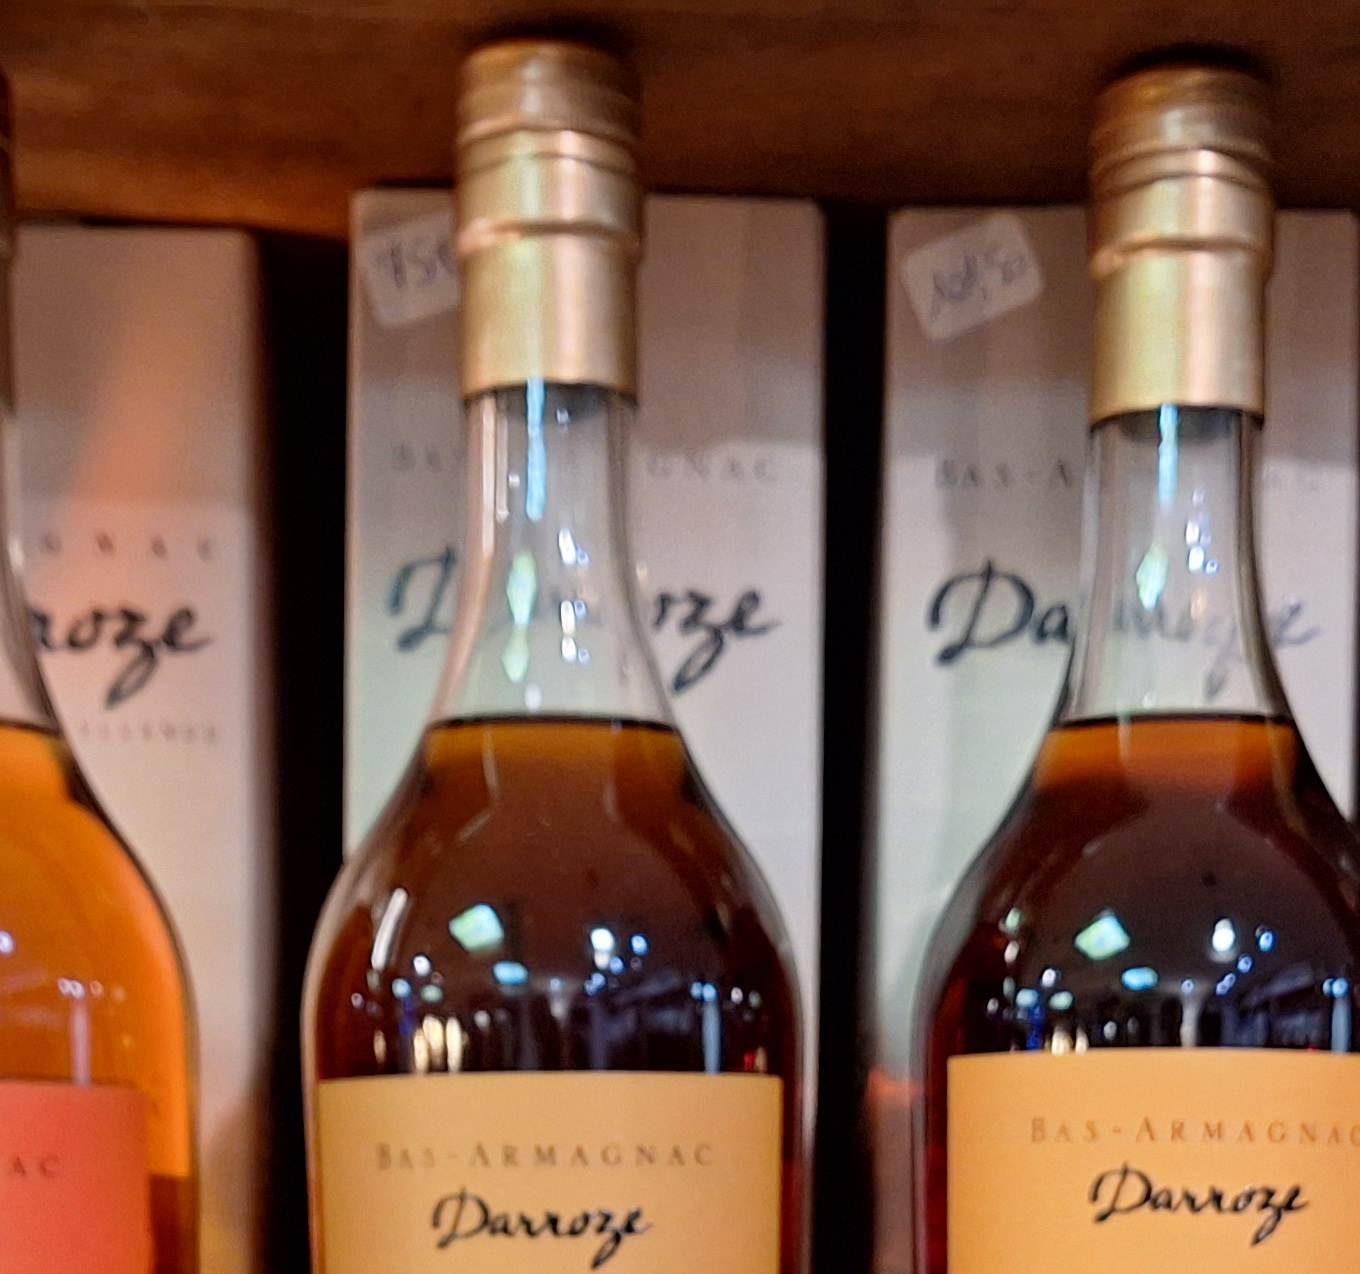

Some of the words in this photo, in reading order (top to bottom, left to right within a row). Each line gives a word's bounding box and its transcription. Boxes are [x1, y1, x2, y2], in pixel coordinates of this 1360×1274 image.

[375, 1142, 714, 1171] BAS-ARMAGNAC
[431, 1186, 653, 1271] Darroze
[1089, 1162, 1309, 1246] Darroze
